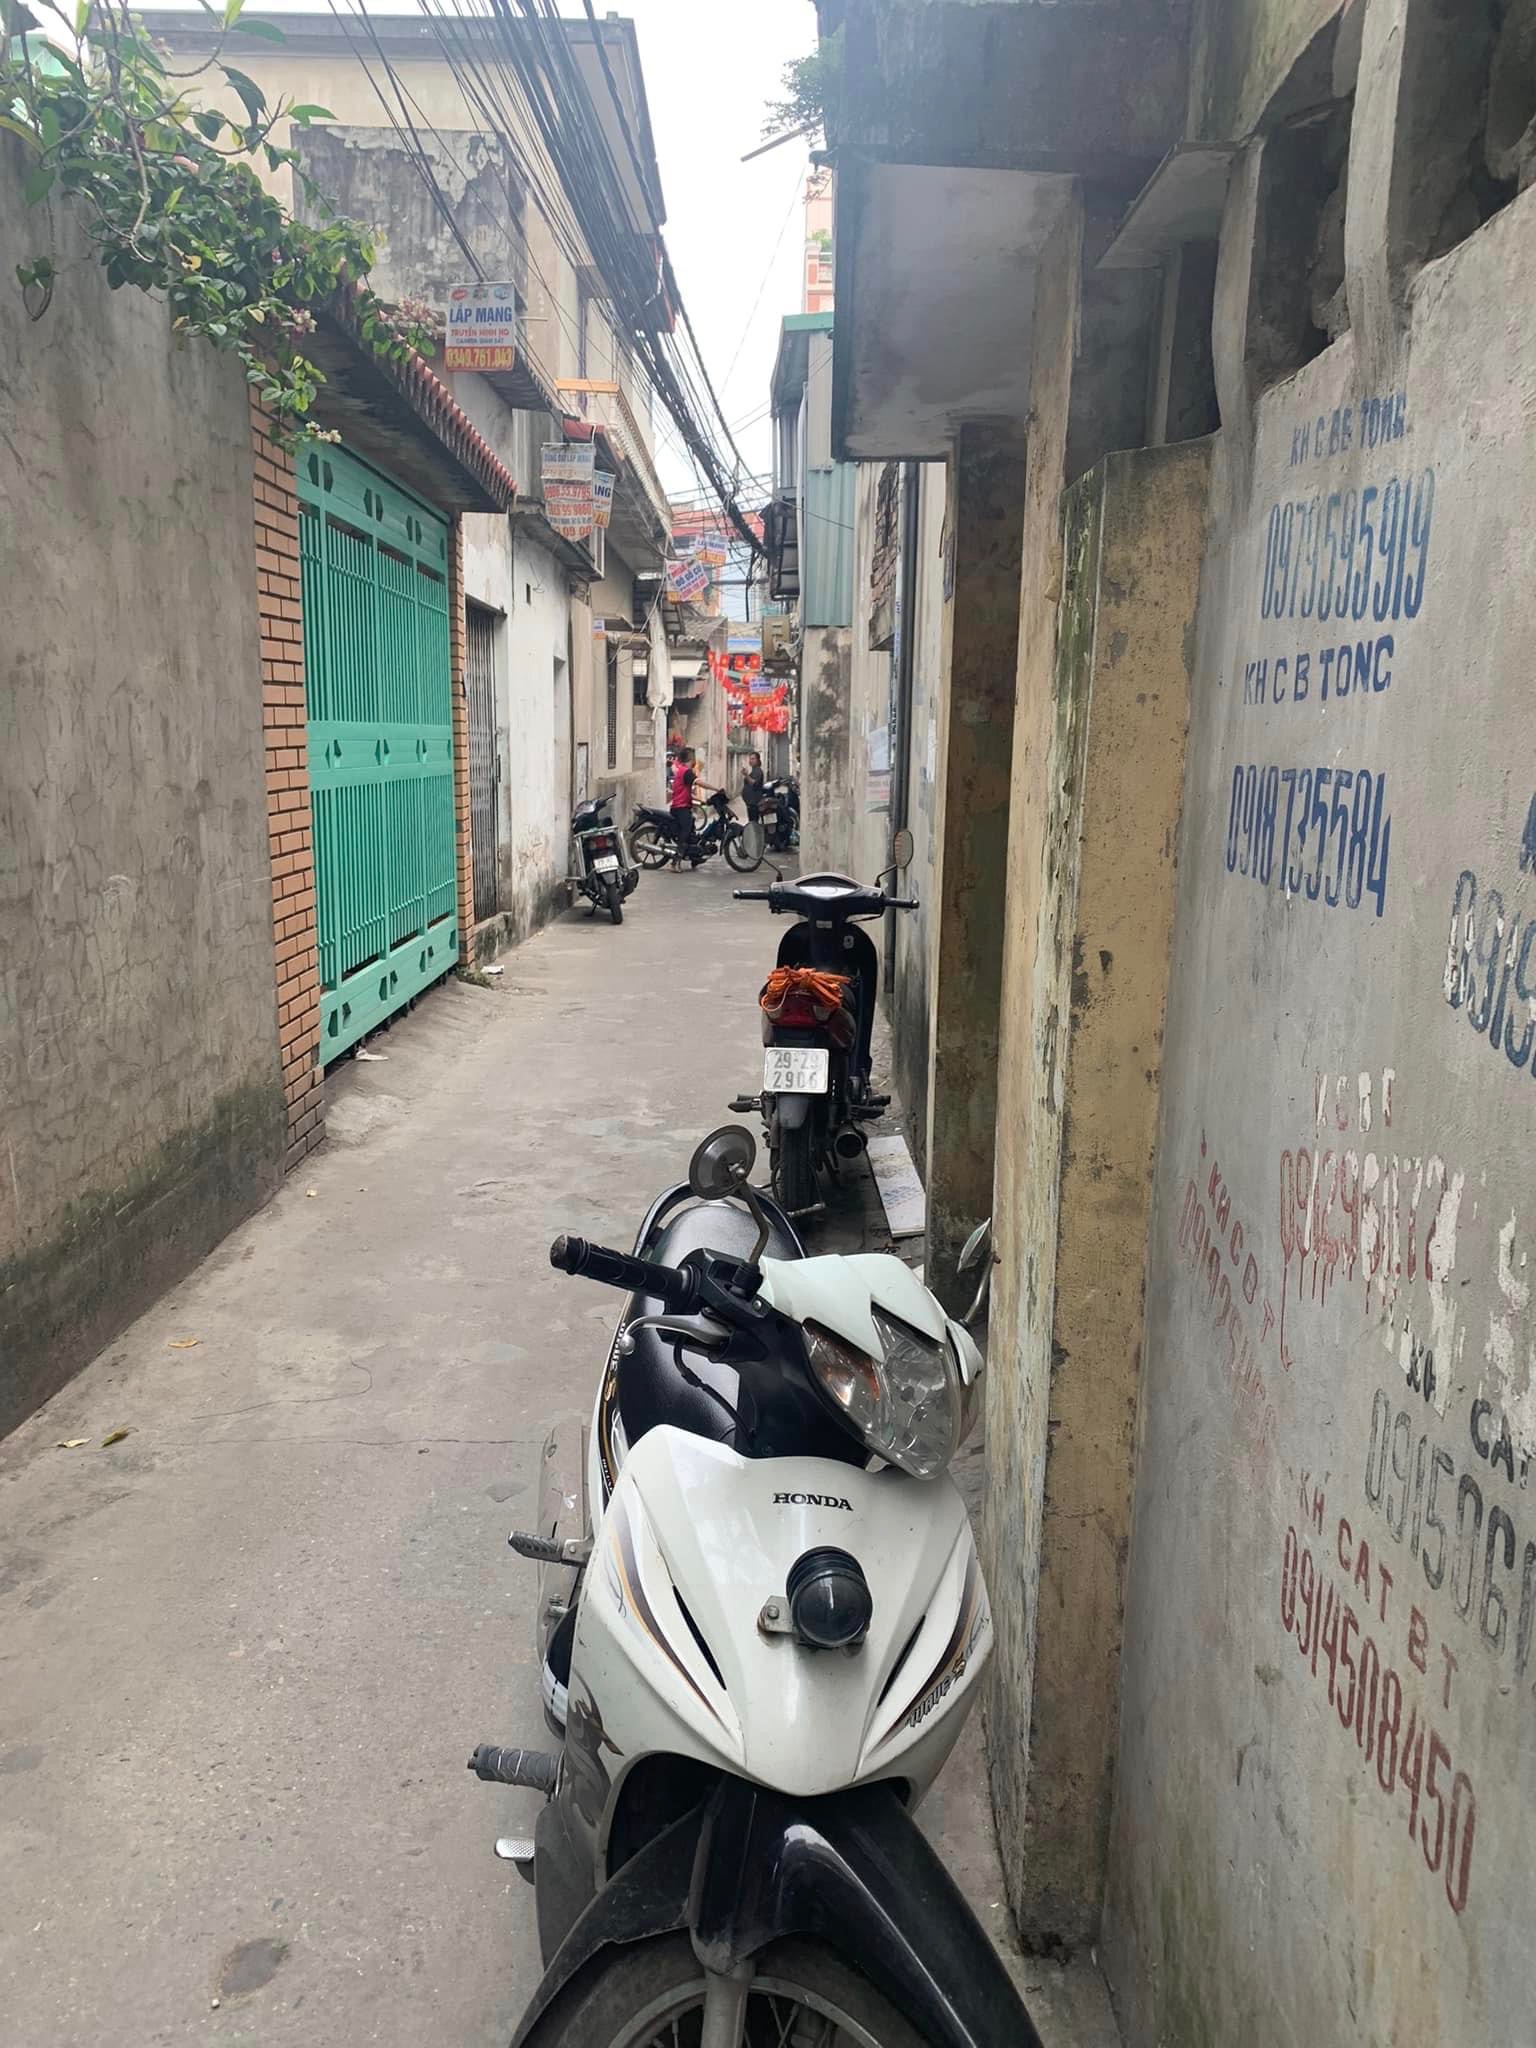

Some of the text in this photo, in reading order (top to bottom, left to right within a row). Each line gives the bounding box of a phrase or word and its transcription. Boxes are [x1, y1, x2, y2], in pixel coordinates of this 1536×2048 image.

[475, 306, 512, 326] MẠNG
[1243, 659, 1268, 705] KH
[1225, 764, 1391, 918] 0918735584
[772, 1491, 853, 1511] HONDA
[1337, 1516, 1394, 1624] CAT
[1280, 1524, 1477, 1915] 0914508450
